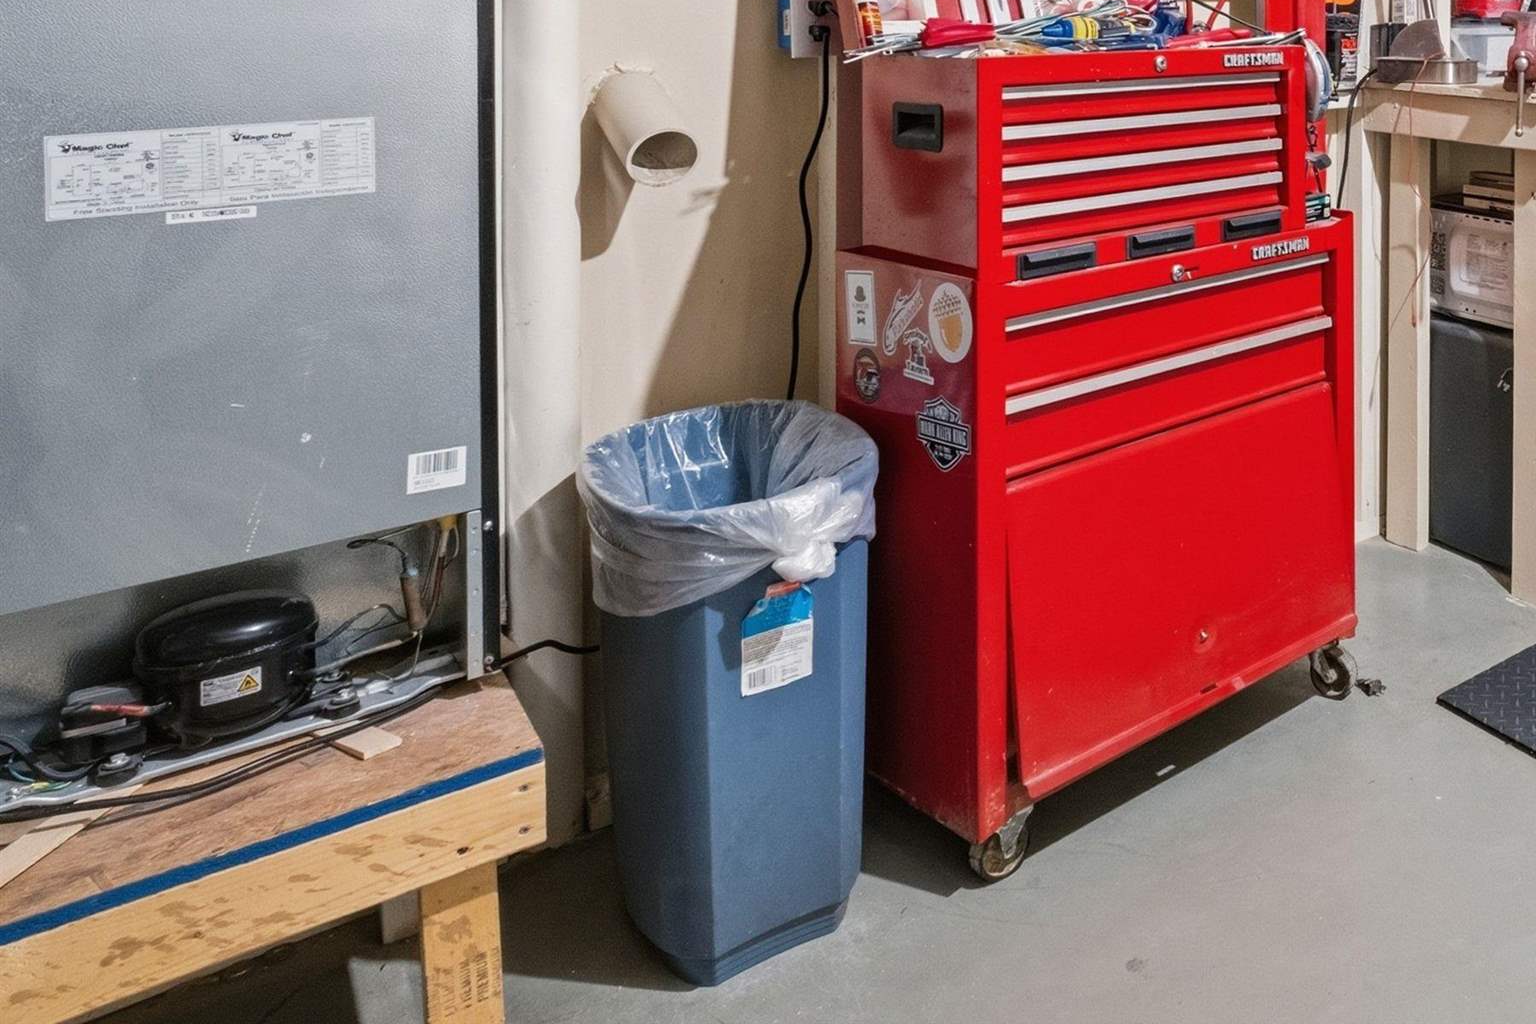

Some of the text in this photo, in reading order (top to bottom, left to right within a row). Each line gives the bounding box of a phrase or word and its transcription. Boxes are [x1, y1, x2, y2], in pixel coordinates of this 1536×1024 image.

[1223, 52, 1285, 68] CRAFTSMAN
[241, 130, 293, 142] Magic Chef
[71, 141, 131, 153] Magic Chef
[1252, 235, 1310, 261] CRAFTSMAN
